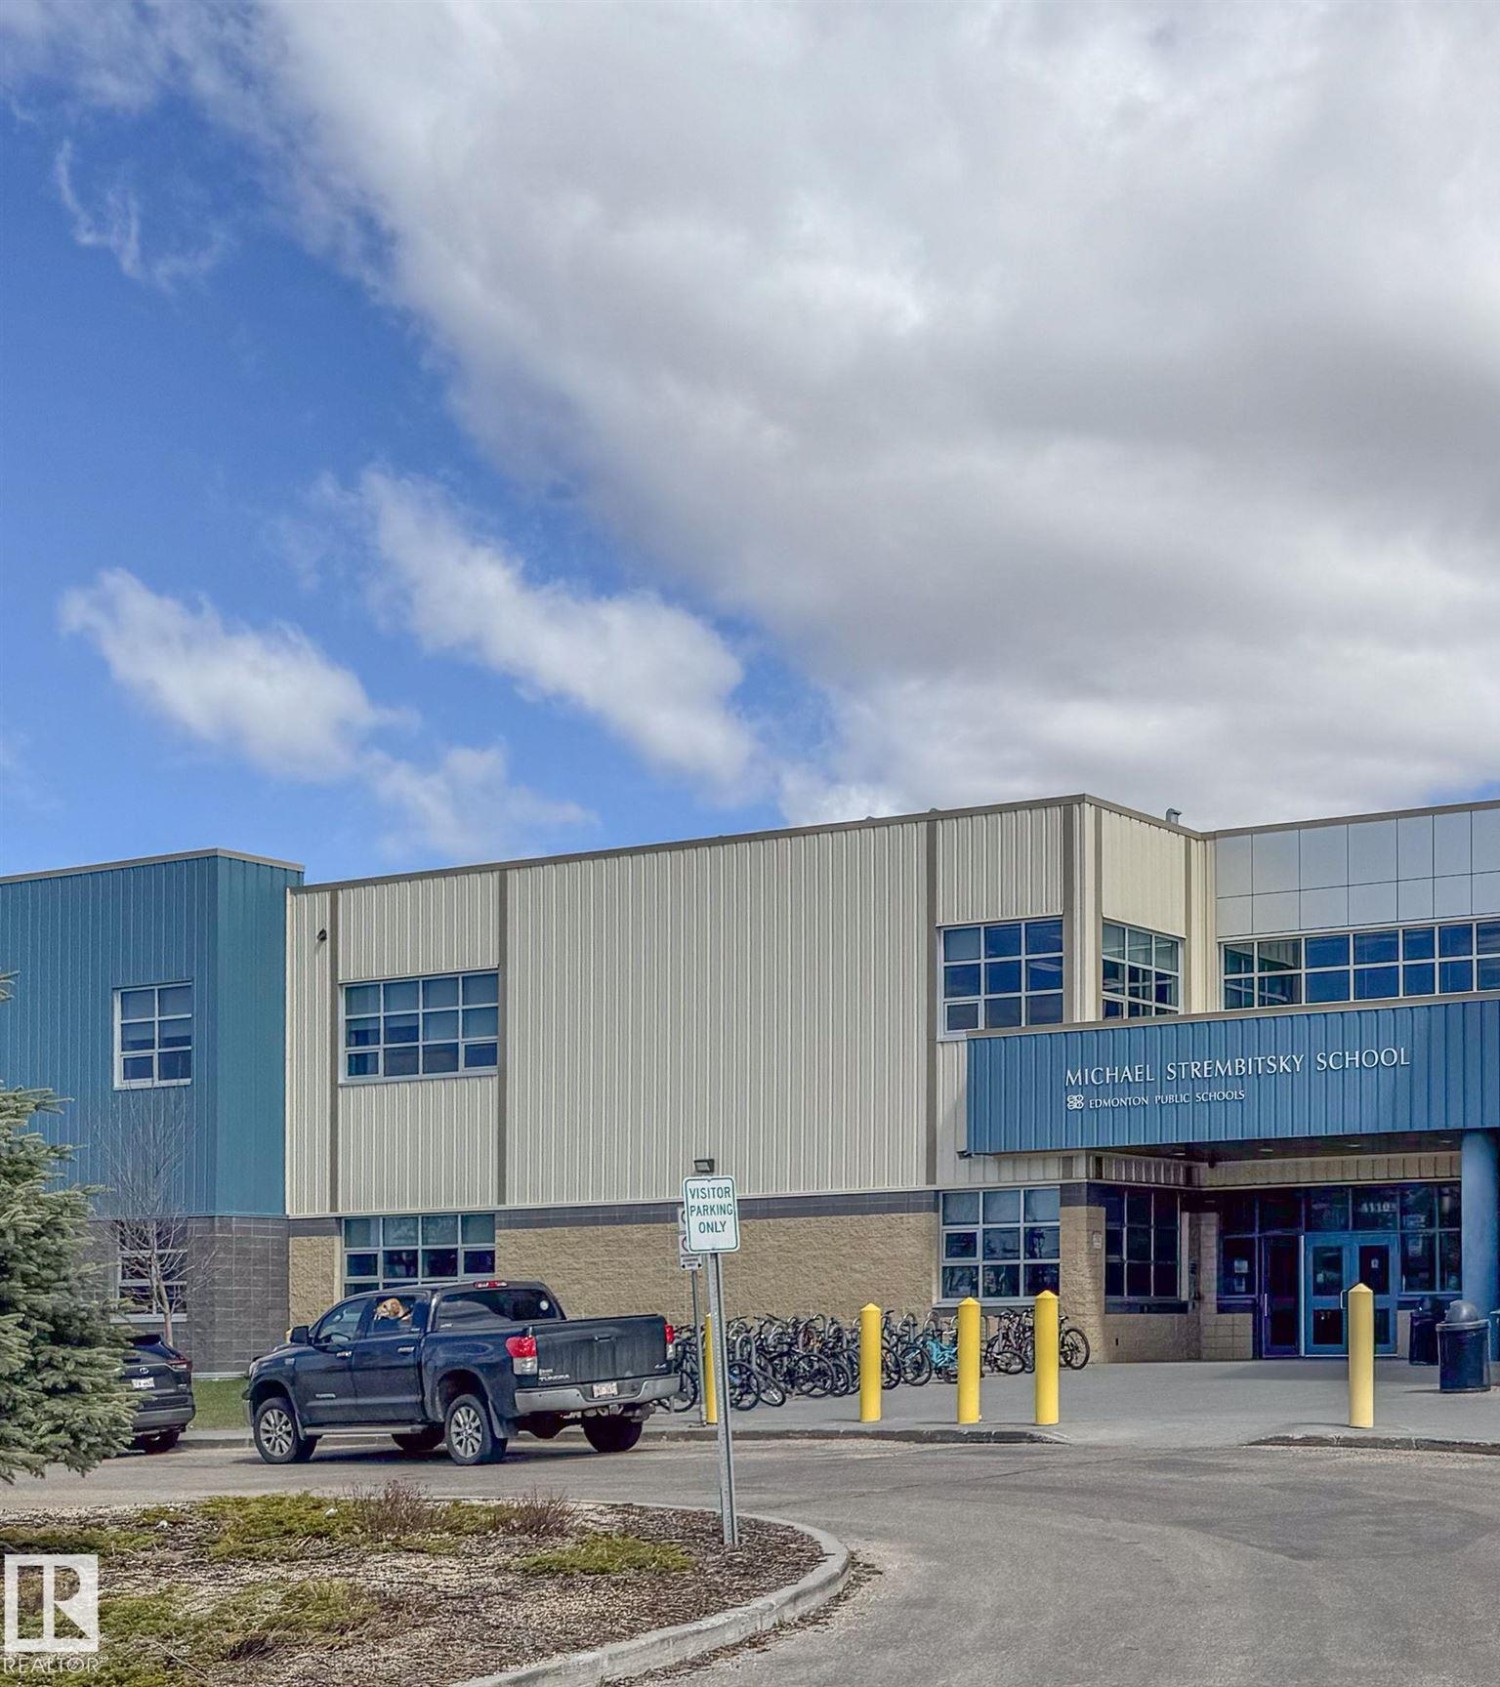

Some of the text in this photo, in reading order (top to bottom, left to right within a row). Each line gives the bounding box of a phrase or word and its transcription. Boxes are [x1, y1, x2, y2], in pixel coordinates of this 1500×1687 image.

[1065, 1047, 1410, 1086] MICHAEL STREMBITSKY SCHOOL
[1089, 1090, 1245, 1109] EDMONTON PUBLIC SCHOOLS
[689, 1186, 731, 1199] VISITOR
[690, 1203, 733, 1216] PARKING
[698, 1220, 727, 1233] ONLY
